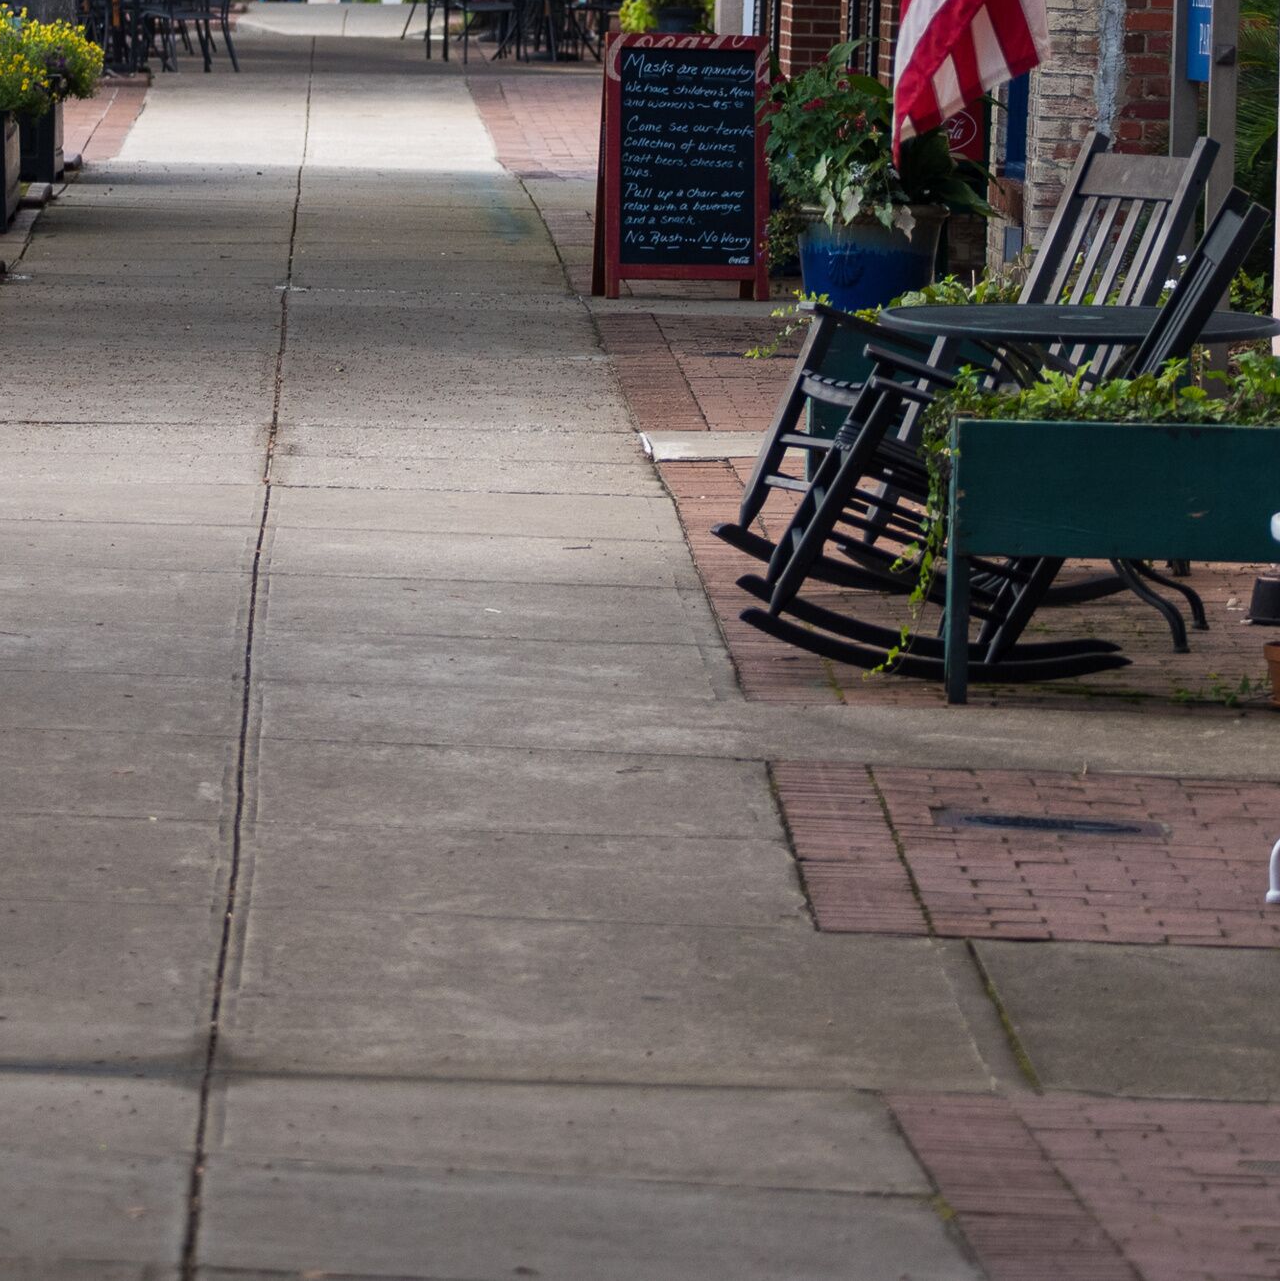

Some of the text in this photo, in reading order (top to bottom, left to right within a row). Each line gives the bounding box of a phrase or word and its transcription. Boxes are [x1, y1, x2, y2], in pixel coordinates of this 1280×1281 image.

[623, 53, 756, 83] Masks are mandatory
[625, 80, 643, 94] We
[644, 82, 670, 96] have
[624, 97, 645, 108] and
[626, 115, 756, 138] Come see our terrific
[680, 139, 696, 154] of
[624, 182, 654, 198] Pull
[657, 189, 674, 201] up
[676, 189, 685, 198] a
[720, 189, 745, 199] and
[623, 201, 742, 216] relax with a beverage
[623, 215, 646, 226] and
[647, 216, 657, 225] a
[624, 230, 645, 244] No
[697, 230, 719, 244] No
[720, 232, 752, 251] Worry
